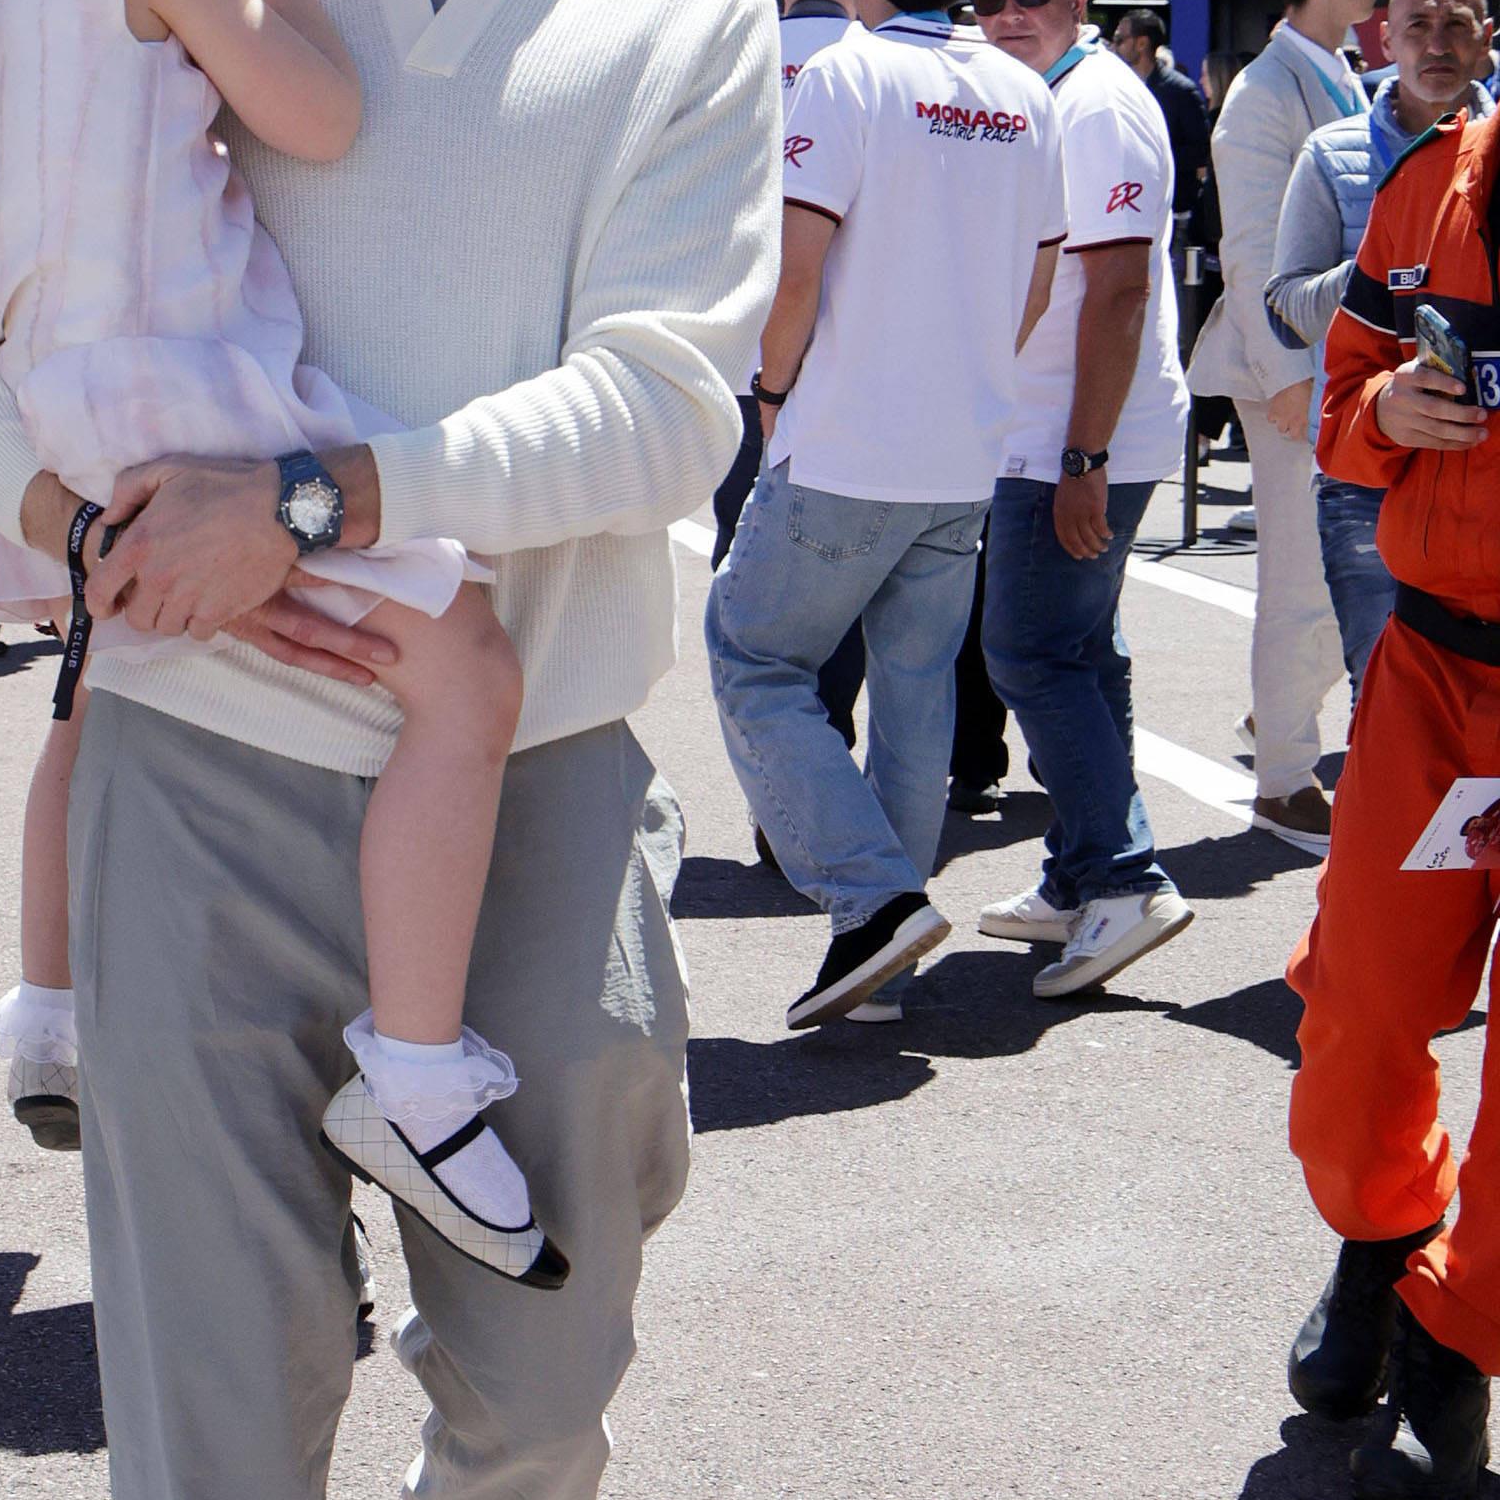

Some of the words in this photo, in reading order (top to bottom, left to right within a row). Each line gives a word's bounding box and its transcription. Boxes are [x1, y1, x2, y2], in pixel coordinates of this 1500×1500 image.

[915, 101, 1028, 132] MONACO
[928, 119, 976, 141] ELECTRIC
[979, 127, 1019, 143] RACE
[1105, 181, 1144, 214] ER
[67, 631, 84, 669] CLUB
